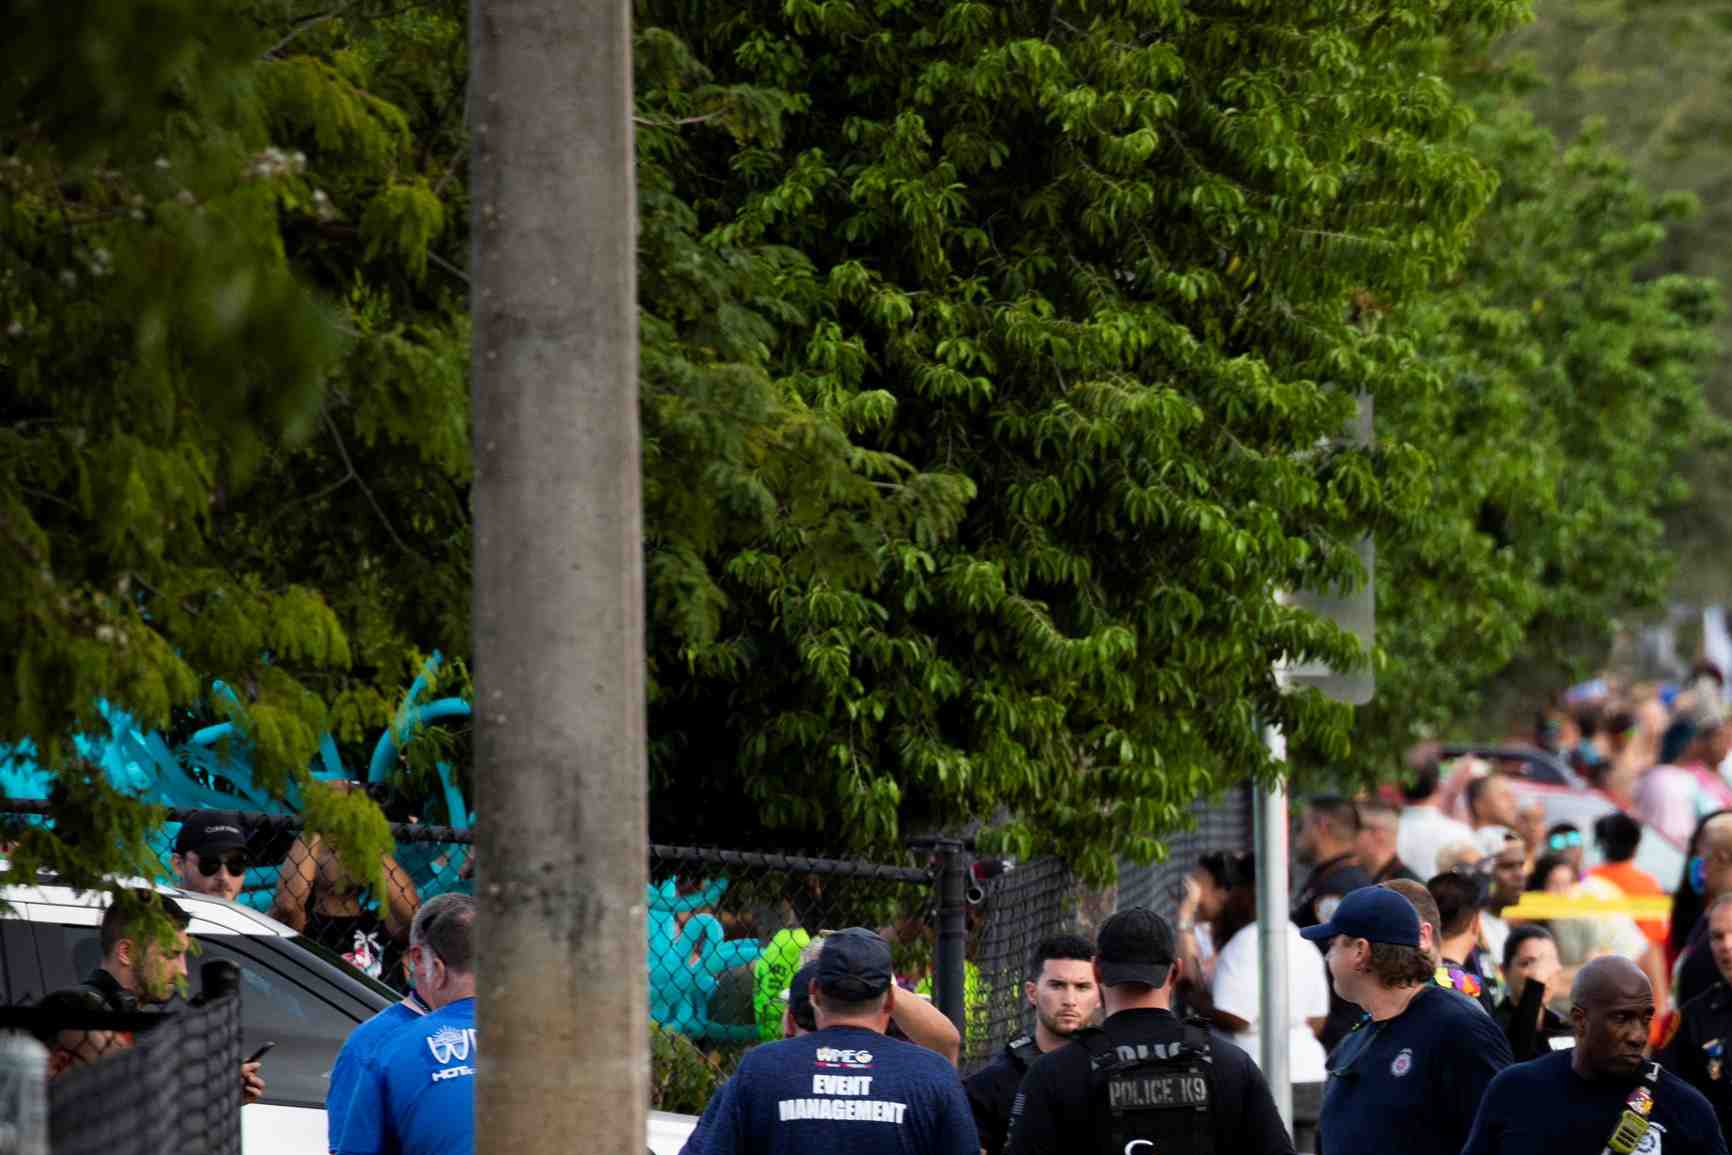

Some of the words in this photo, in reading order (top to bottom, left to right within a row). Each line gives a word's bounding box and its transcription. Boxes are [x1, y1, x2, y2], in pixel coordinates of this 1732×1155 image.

[813, 1074, 873, 1096] EVENT
[1108, 1078, 1175, 1107] POLICE
[1180, 1077, 1208, 1102] K9
[778, 1099, 908, 1124] MANAGEMENT
